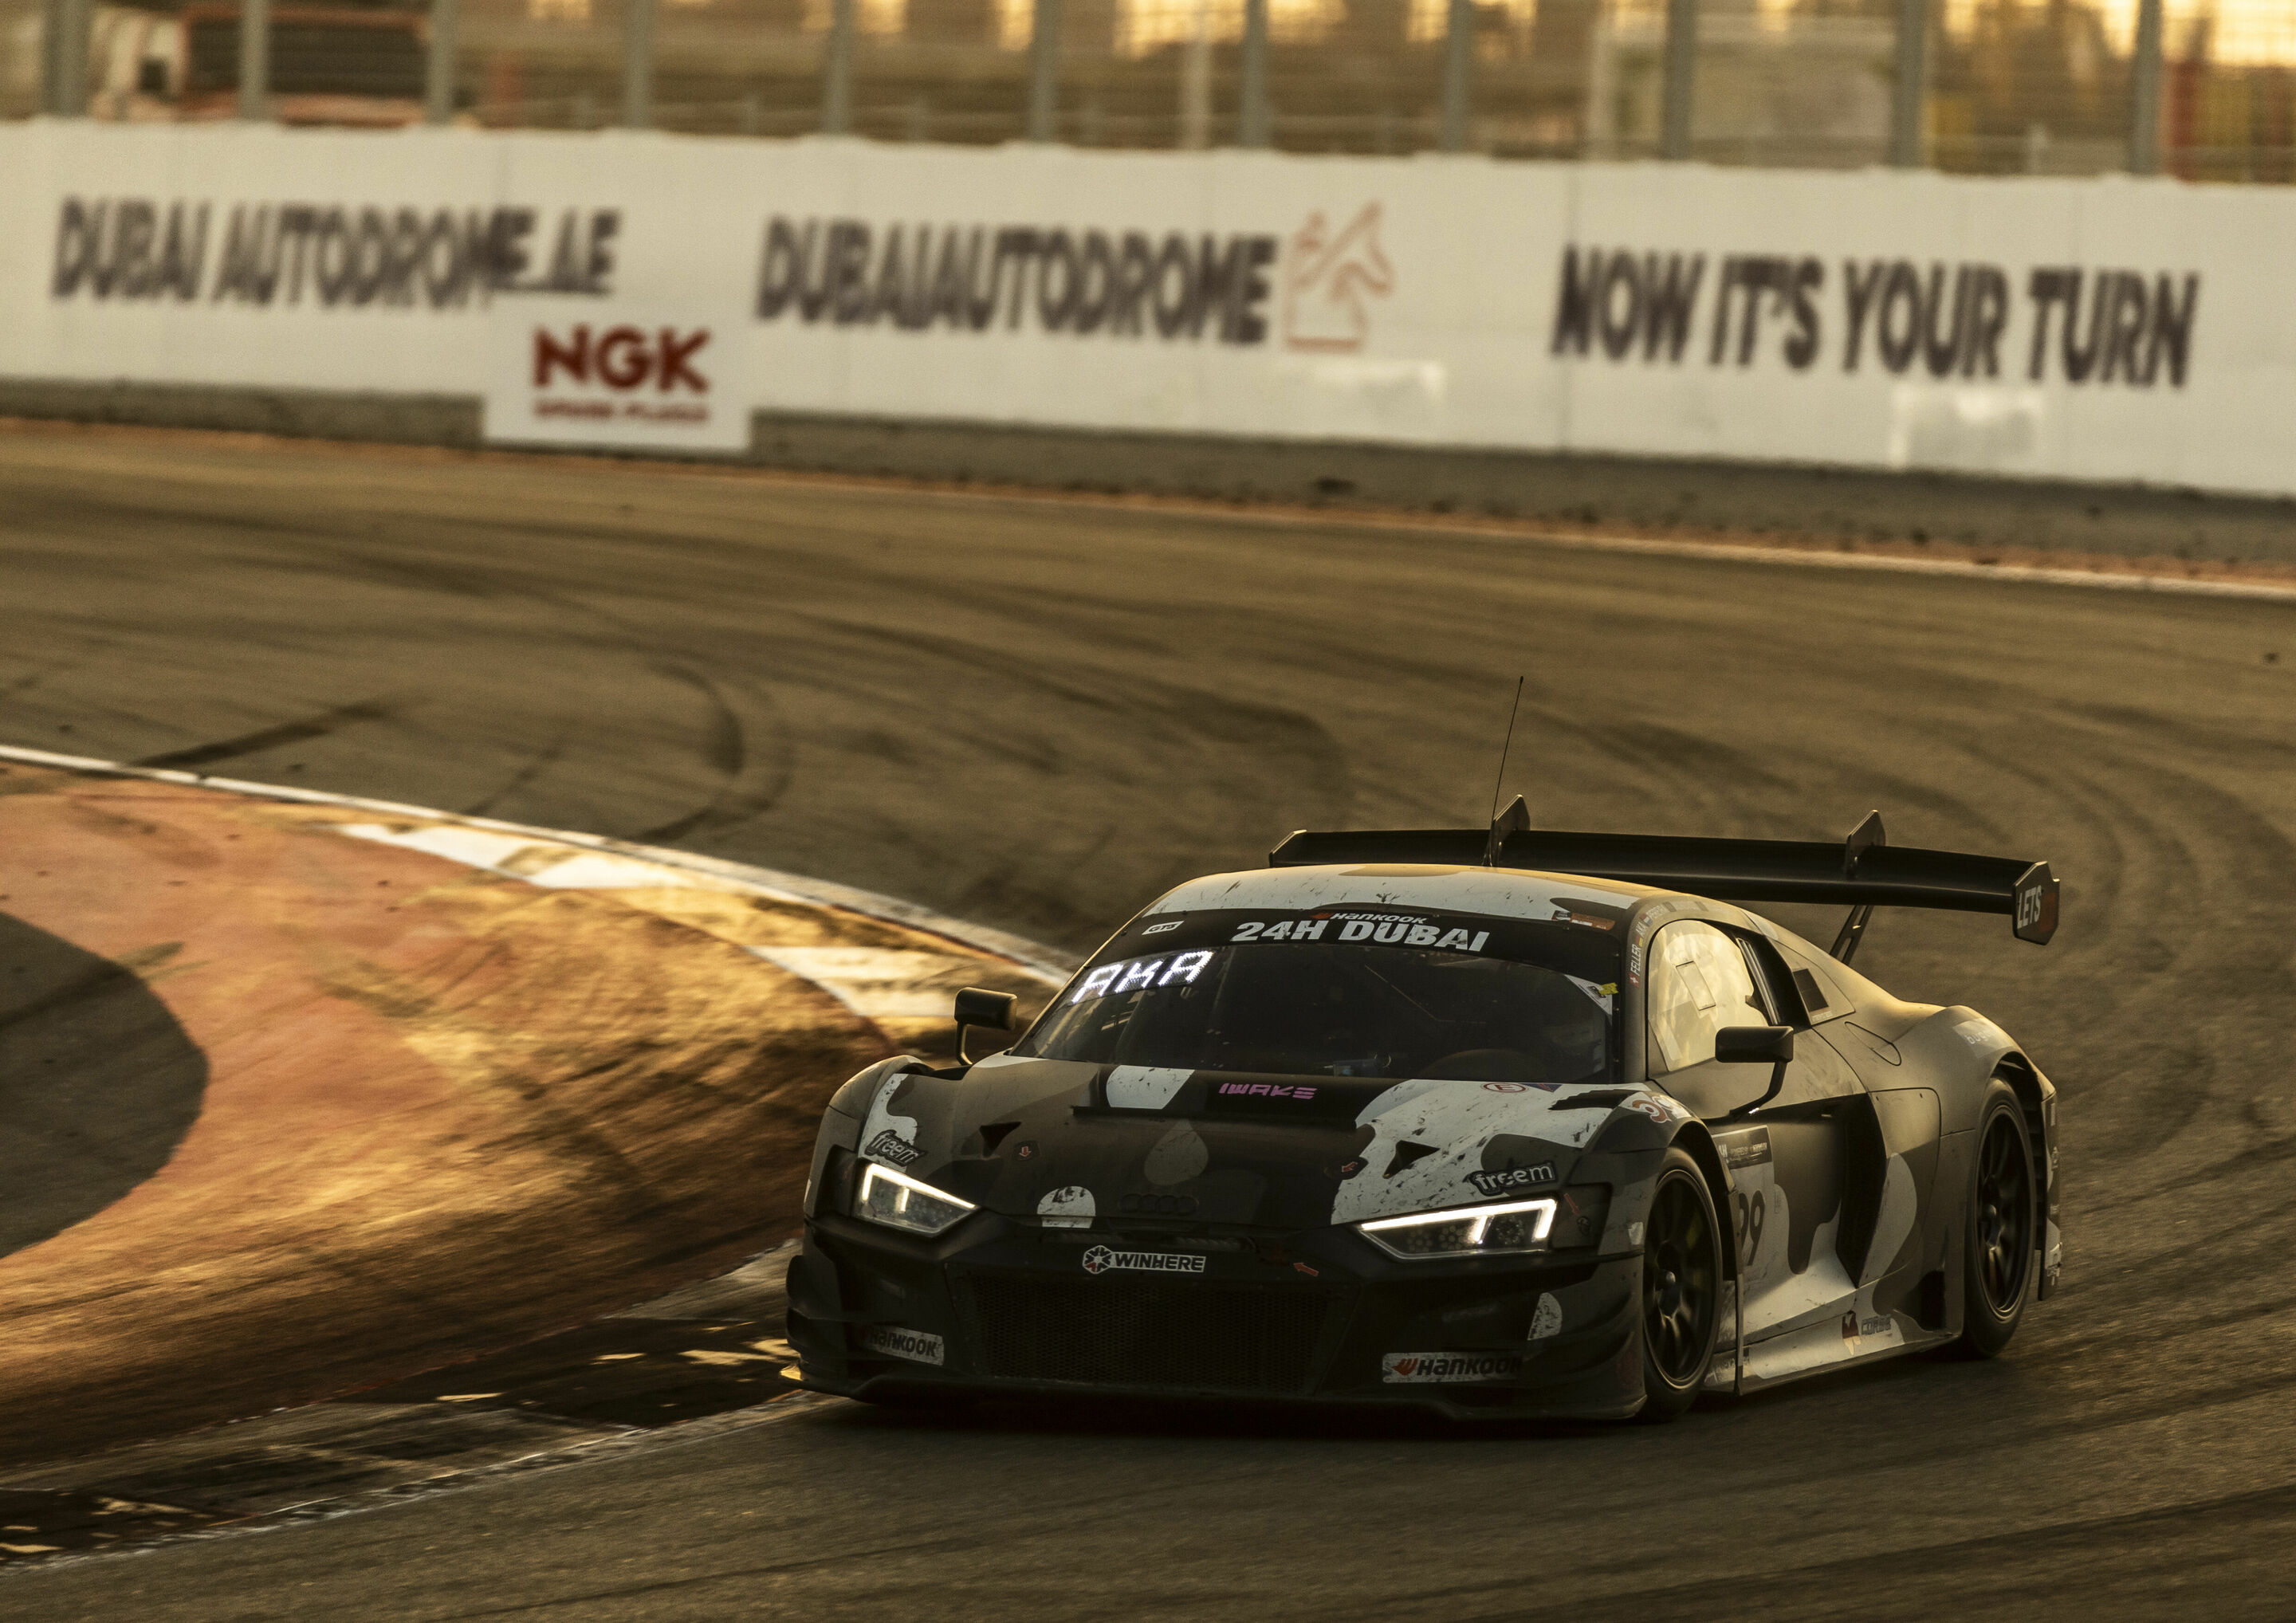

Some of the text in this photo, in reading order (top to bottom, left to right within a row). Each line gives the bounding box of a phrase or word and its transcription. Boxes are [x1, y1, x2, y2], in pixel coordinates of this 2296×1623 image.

[1551, 241, 2200, 391] NOW IT'S YOUR TURN
[532, 322, 711, 395] NGK
[1331, 912, 1428, 925] Hankook
[1230, 920, 1491, 952] 24H DUBAI
[1630, 944, 1642, 977] FELLER
[1474, 1165, 1554, 1191] freem
[1115, 1253, 1204, 1271] WINHERE
